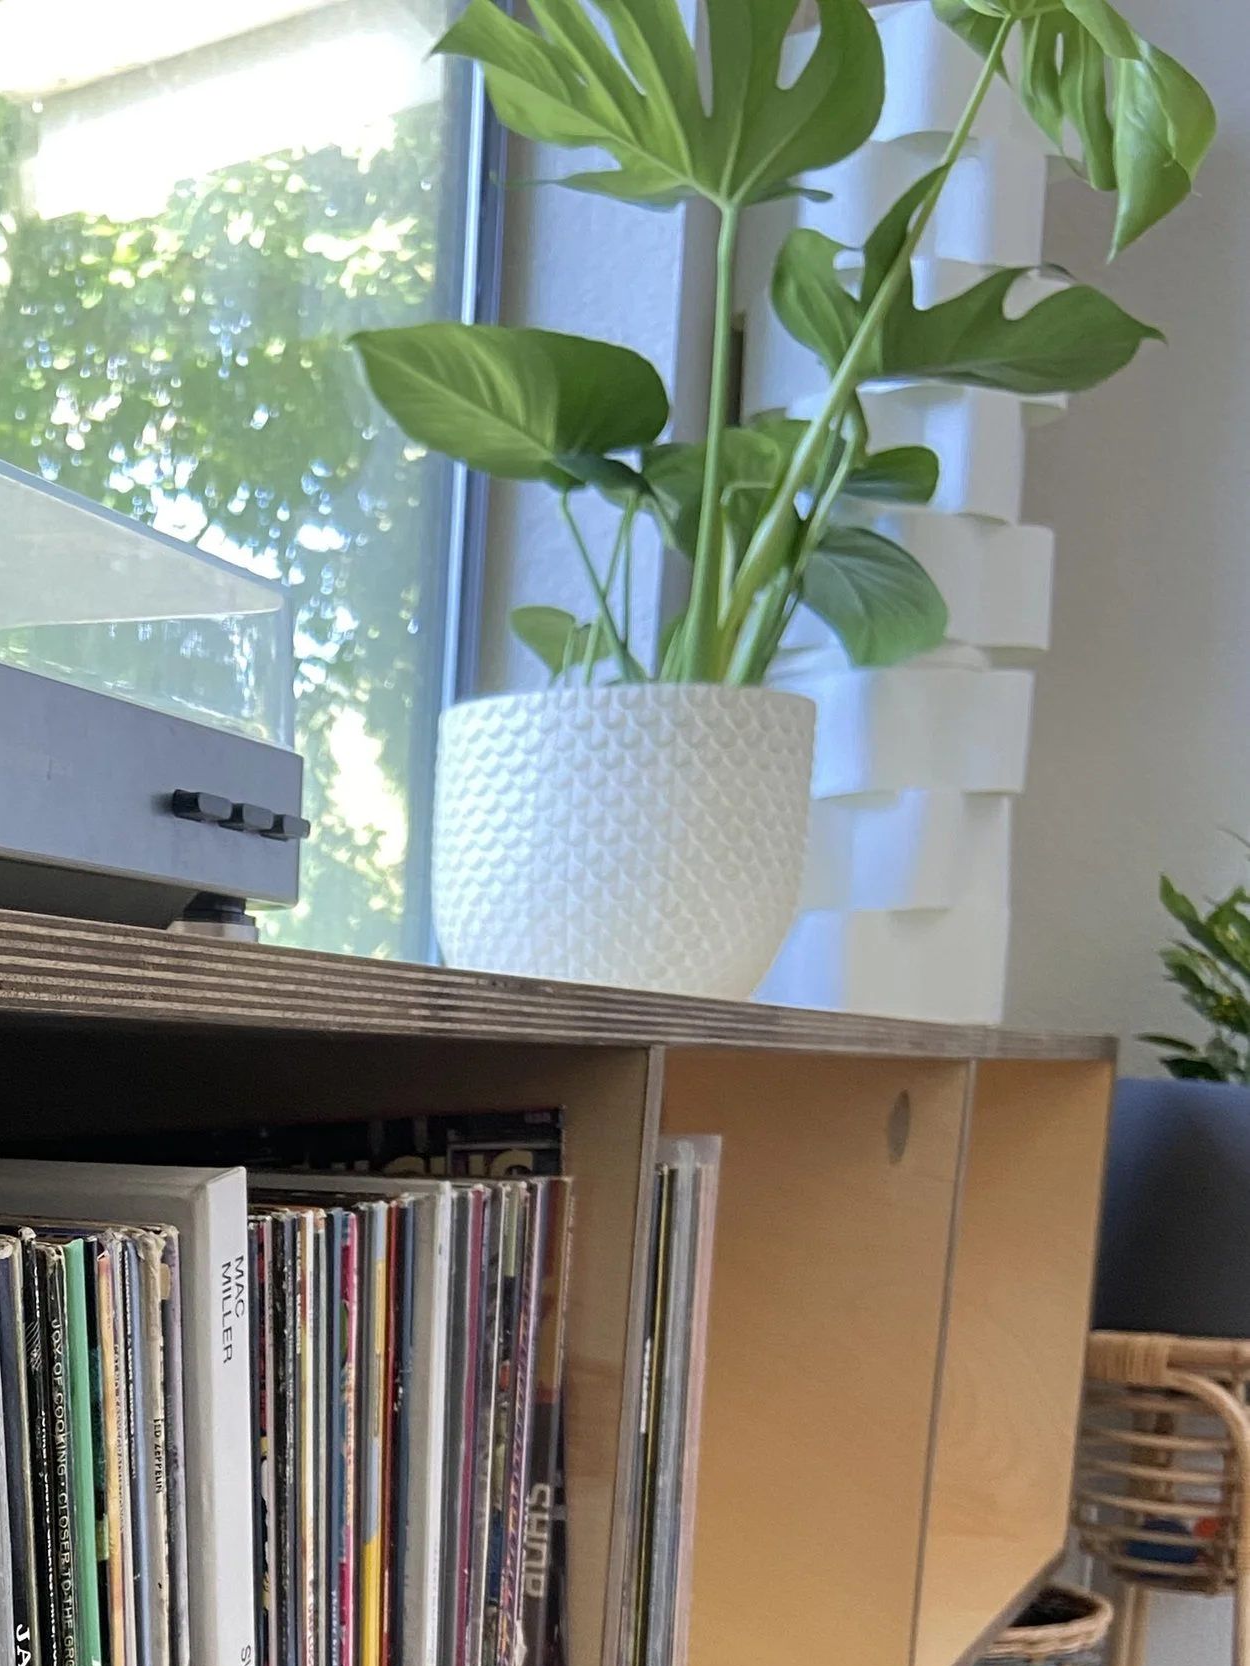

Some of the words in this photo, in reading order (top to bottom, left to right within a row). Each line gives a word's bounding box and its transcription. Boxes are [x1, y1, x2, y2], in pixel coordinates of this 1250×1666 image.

[222, 1260, 234, 1363] MILLER
[235, 1255, 245, 1318] MAC
[51, 1319, 61, 1358] JOY
[53, 1362, 62, 1387] OF
[54, 1393, 67, 1477] COOKING
[153, 1418, 164, 1438] LED
[154, 1443, 163, 1494] ZEPPELIN
[59, 1493, 70, 1563] CLOSER
[62, 1590, 72, 1629] THE
